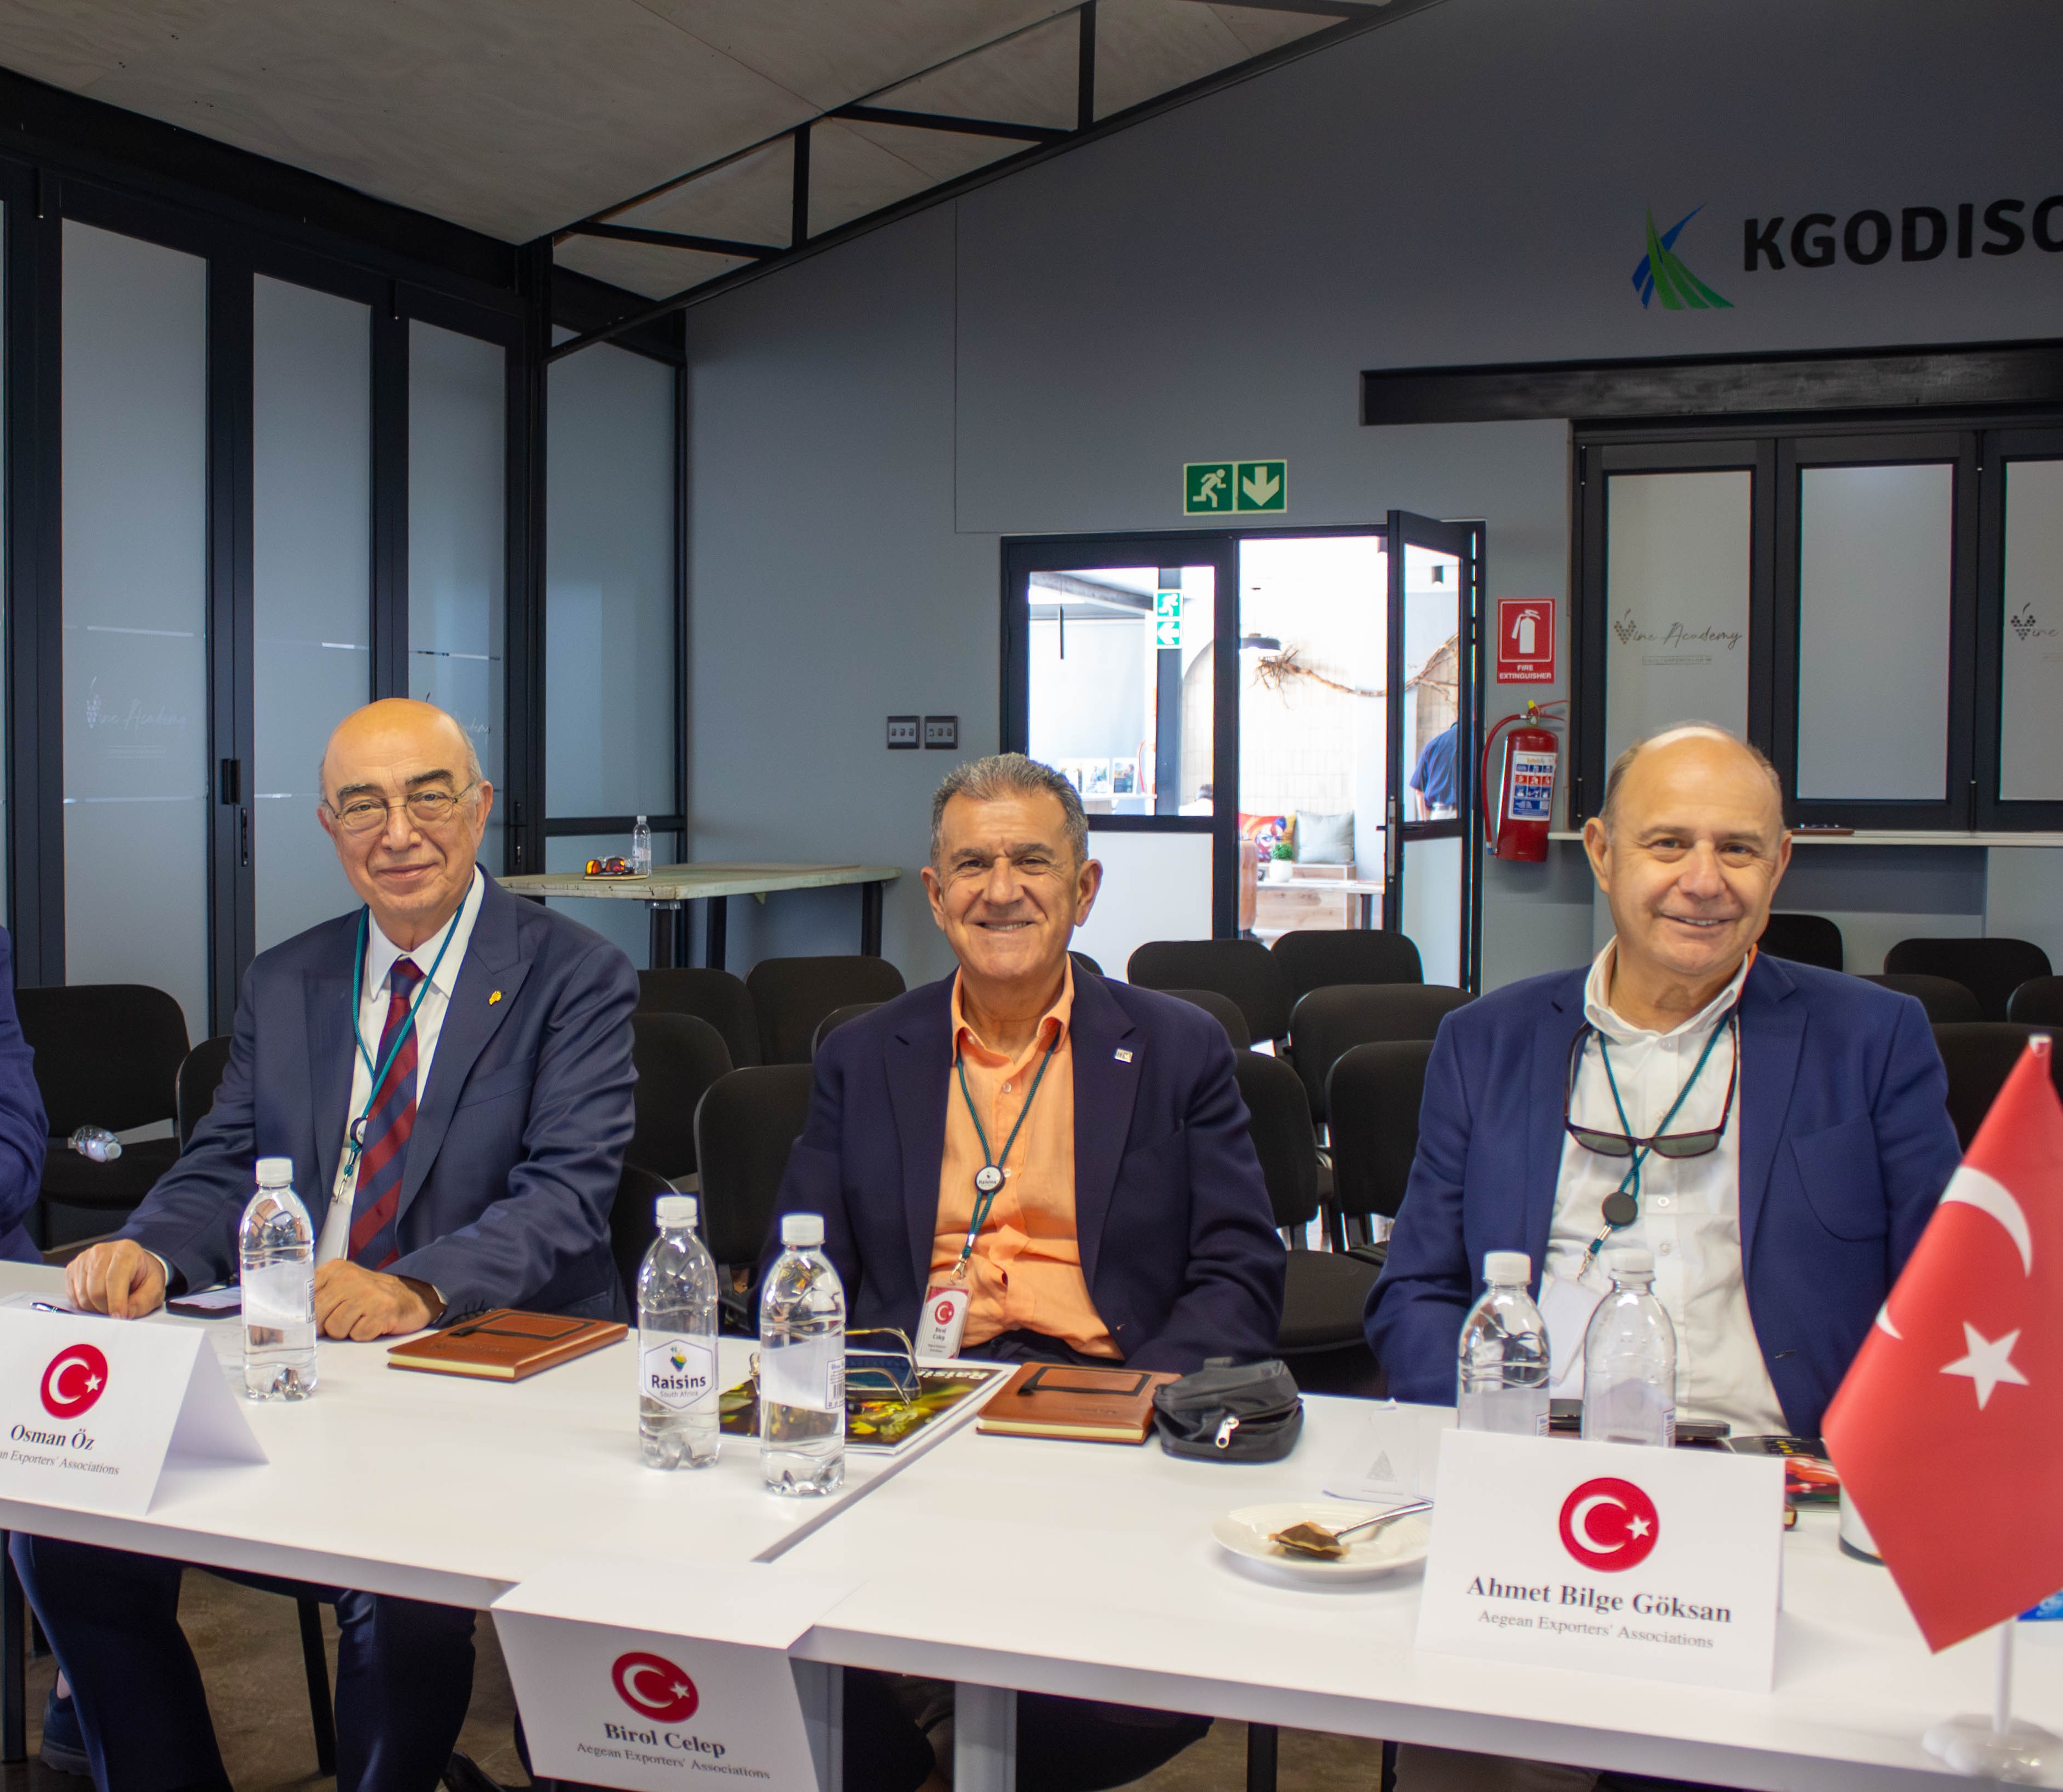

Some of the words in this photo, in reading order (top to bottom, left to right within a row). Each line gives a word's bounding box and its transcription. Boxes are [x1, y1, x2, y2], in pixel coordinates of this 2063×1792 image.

[1662, 622, 1743, 650] Academy
[651, 1374, 706, 1390] Raisins
[10, 1424, 66, 1447] Osman
[71, 1428, 95, 1451] Öz
[10, 1449, 59, 1466] Exporters'
[59, 1458, 120, 1475] Associations
[1466, 1575, 1552, 1603] Ahmet
[1559, 1584, 1624, 1615] Bilge
[1632, 1593, 1732, 1624] Göksan
[1478, 1609, 1533, 1628] Aegean
[1537, 1616, 1613, 1637] Exporters'
[1617, 1625, 1714, 1648] Associations
[603, 1722, 658, 1746] Birol
[663, 1731, 726, 1759] Celep
[577, 1742, 621, 1759] Aegean
[624, 1749, 686, 1768] Exporters'
[691, 1759, 771, 1779] Associations
